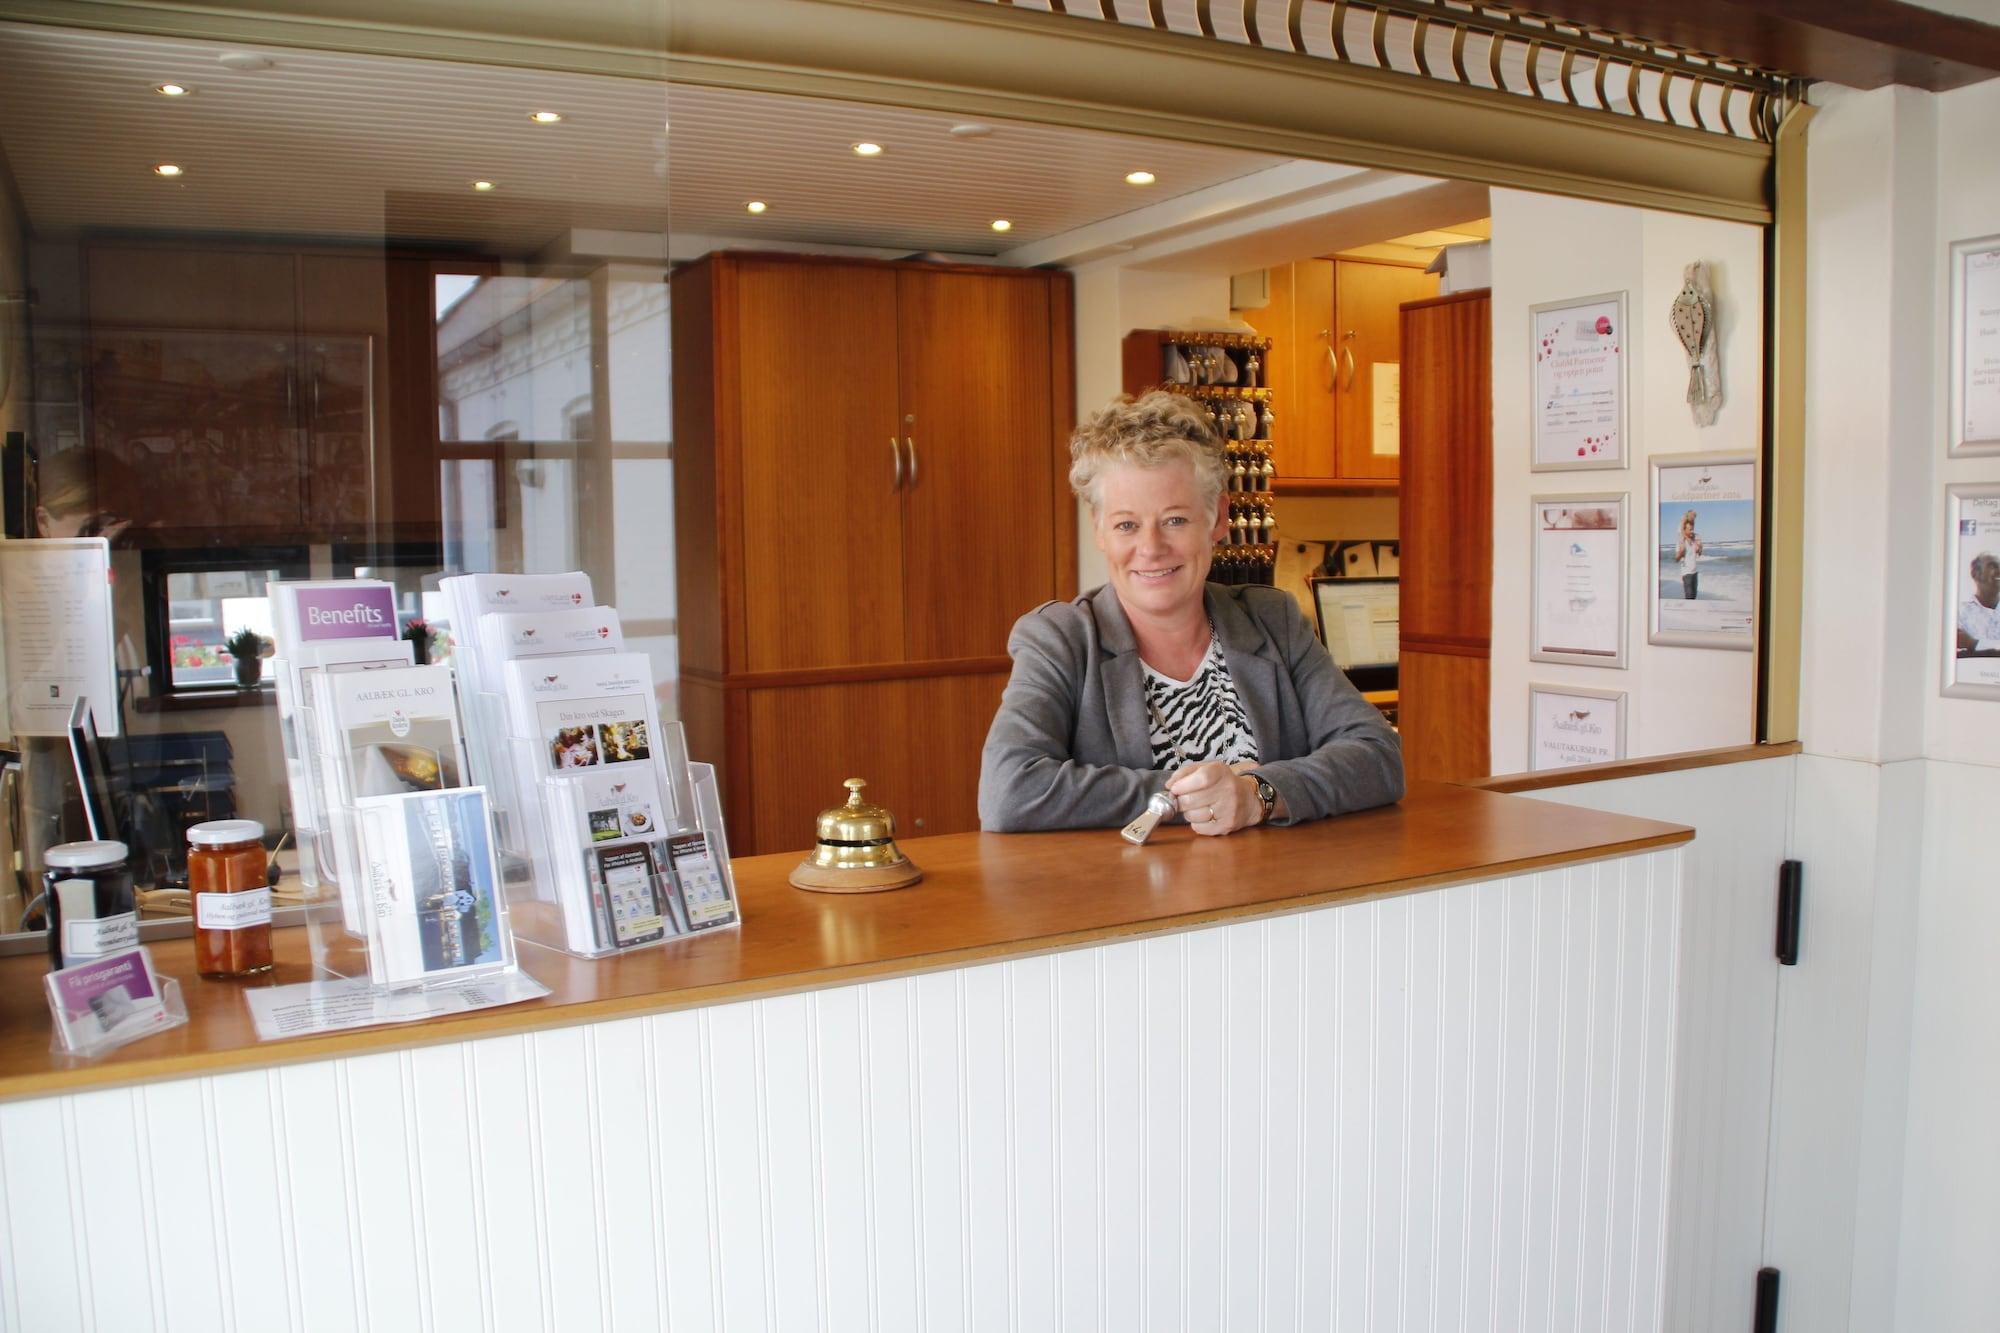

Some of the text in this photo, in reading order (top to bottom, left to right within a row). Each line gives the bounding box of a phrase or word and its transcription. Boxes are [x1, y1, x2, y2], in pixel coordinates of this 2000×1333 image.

[308, 603, 383, 625] Benefits
[356, 688, 394, 701] AALBÆK
[414, 686, 435, 696] KRO
